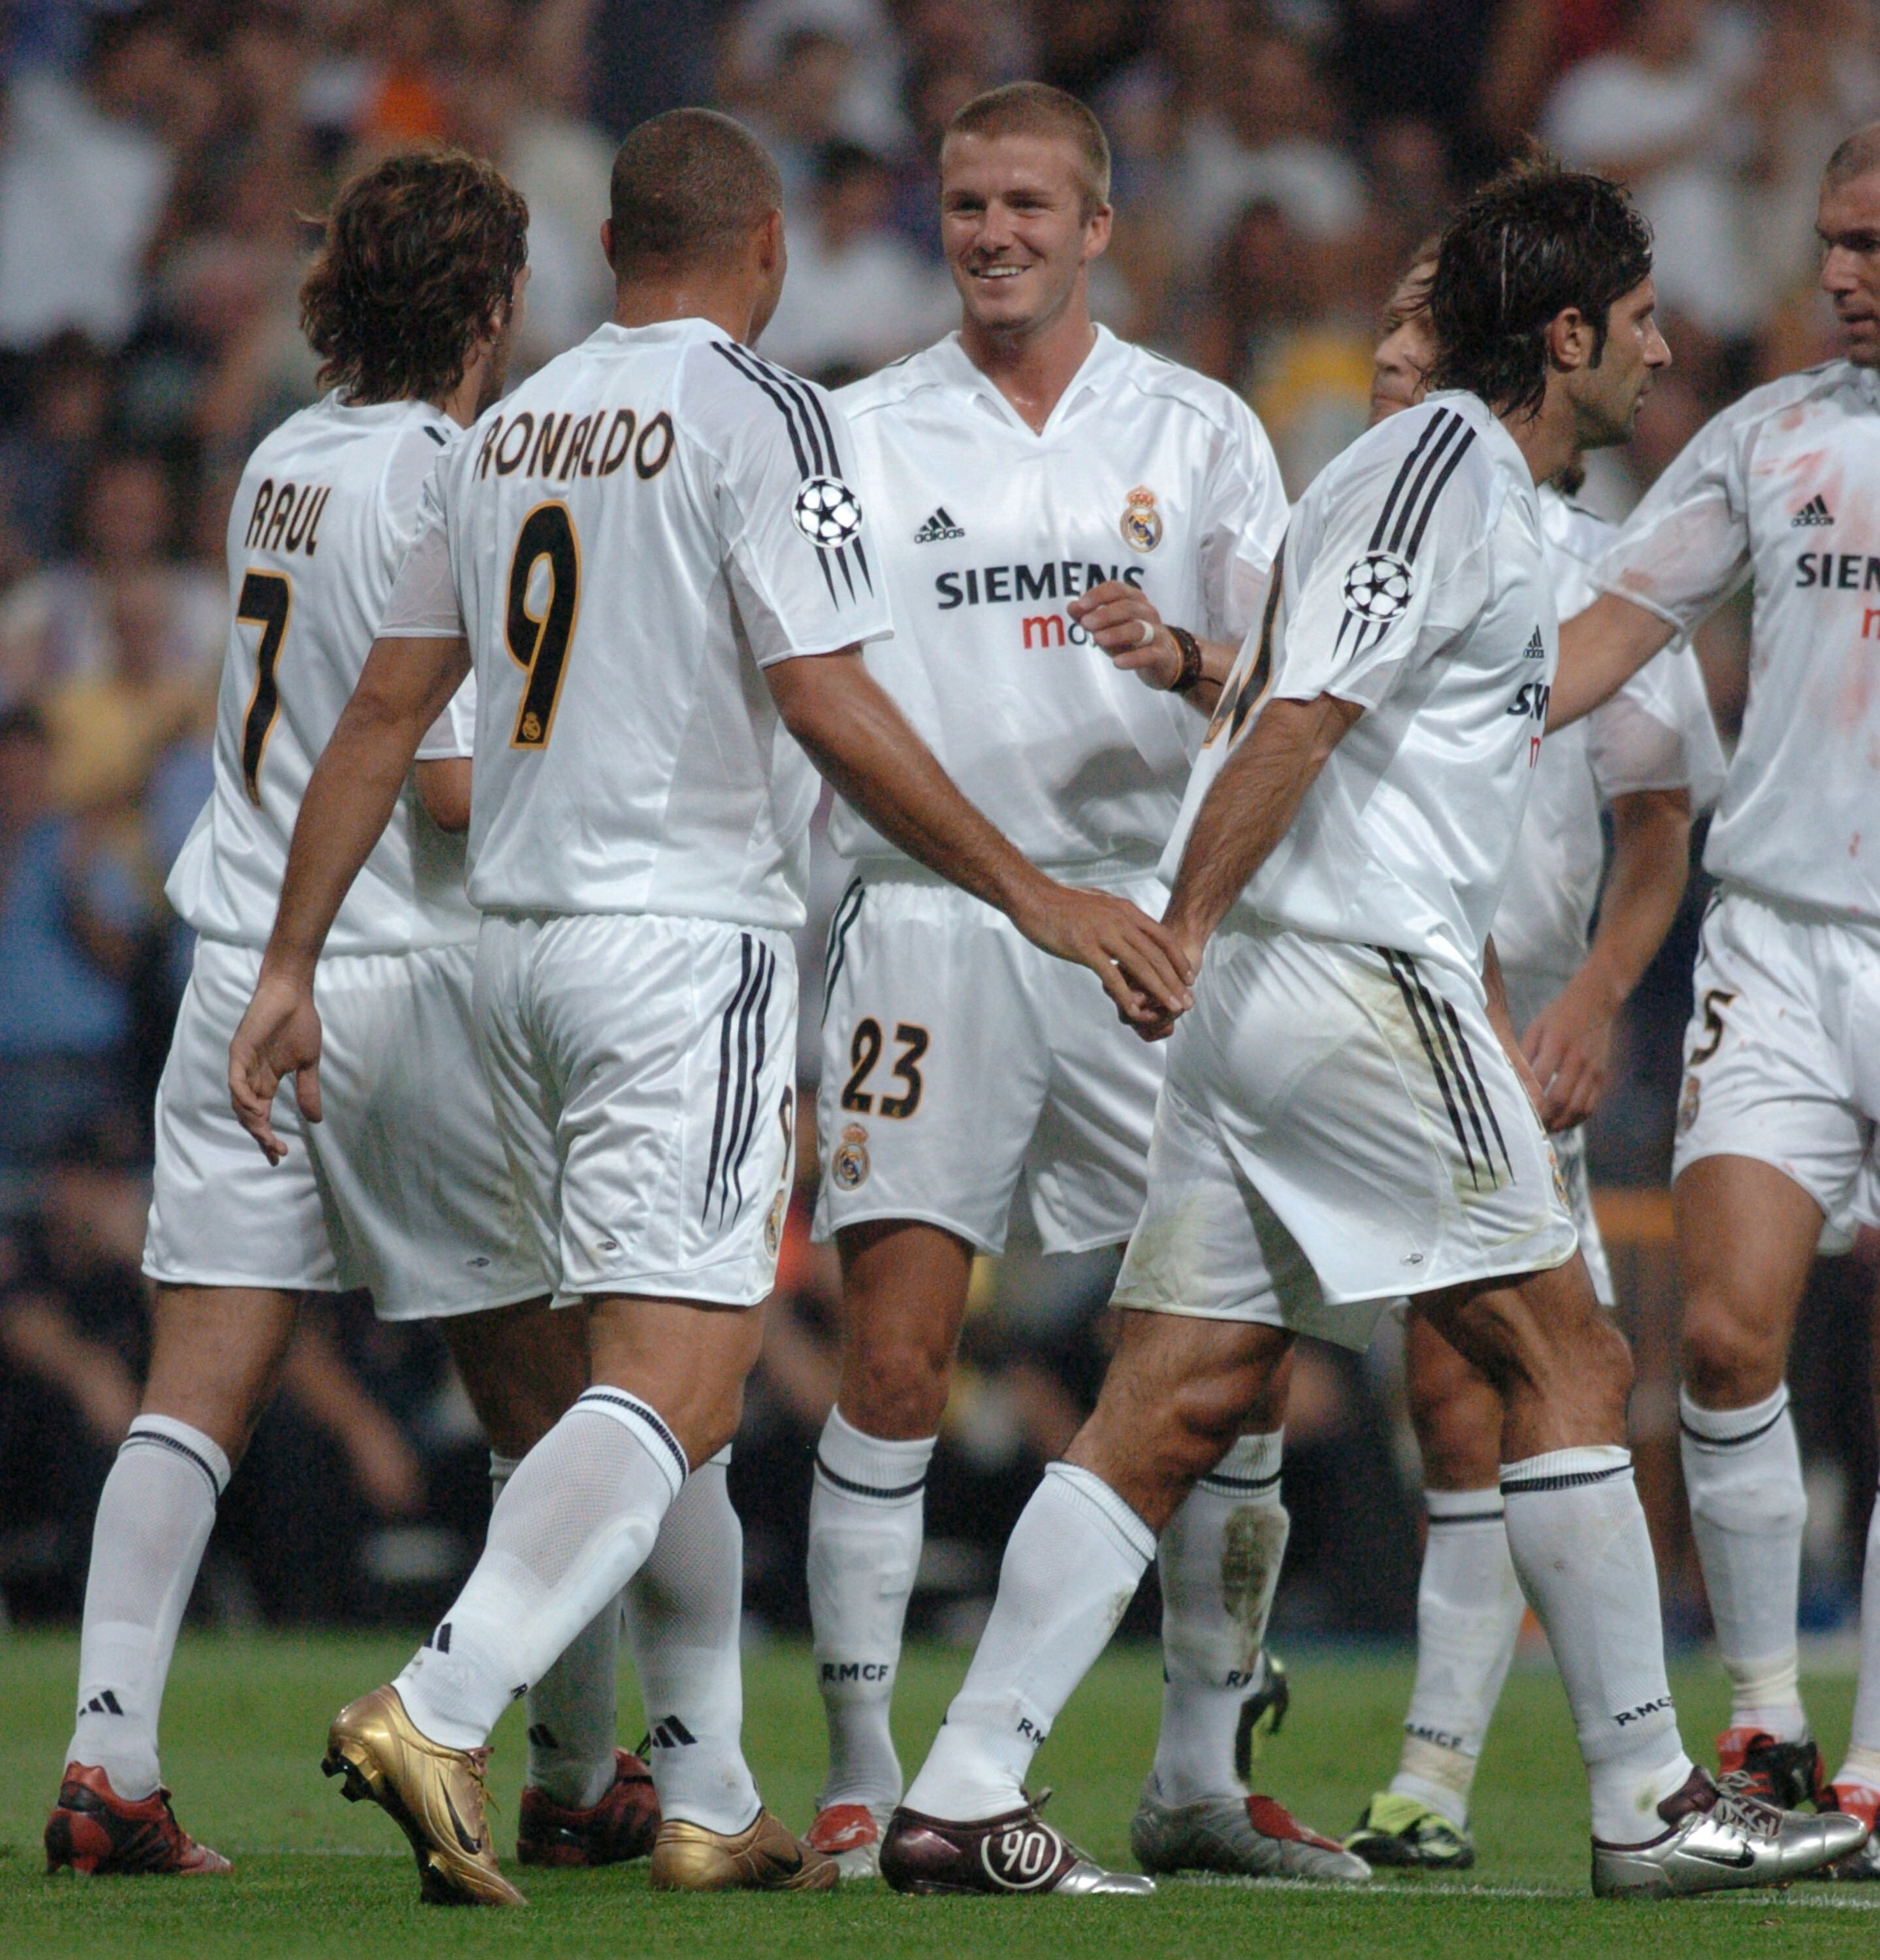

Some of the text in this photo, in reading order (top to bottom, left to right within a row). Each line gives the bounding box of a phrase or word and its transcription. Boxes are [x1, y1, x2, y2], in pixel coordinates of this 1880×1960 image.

[472, 408, 675, 483] RONALDO
[244, 478, 332, 557] RAUL
[915, 528, 965, 544] adidas
[935, 561, 1145, 610] SIEMENS
[504, 499, 581, 750] 9
[236, 567, 292, 808] 7
[1688, 989, 1736, 1066] 5
[841, 1017, 930, 1120] 23
[822, 1663, 888, 1682] RMCF
[1001, 1830, 1046, 1875] 90
